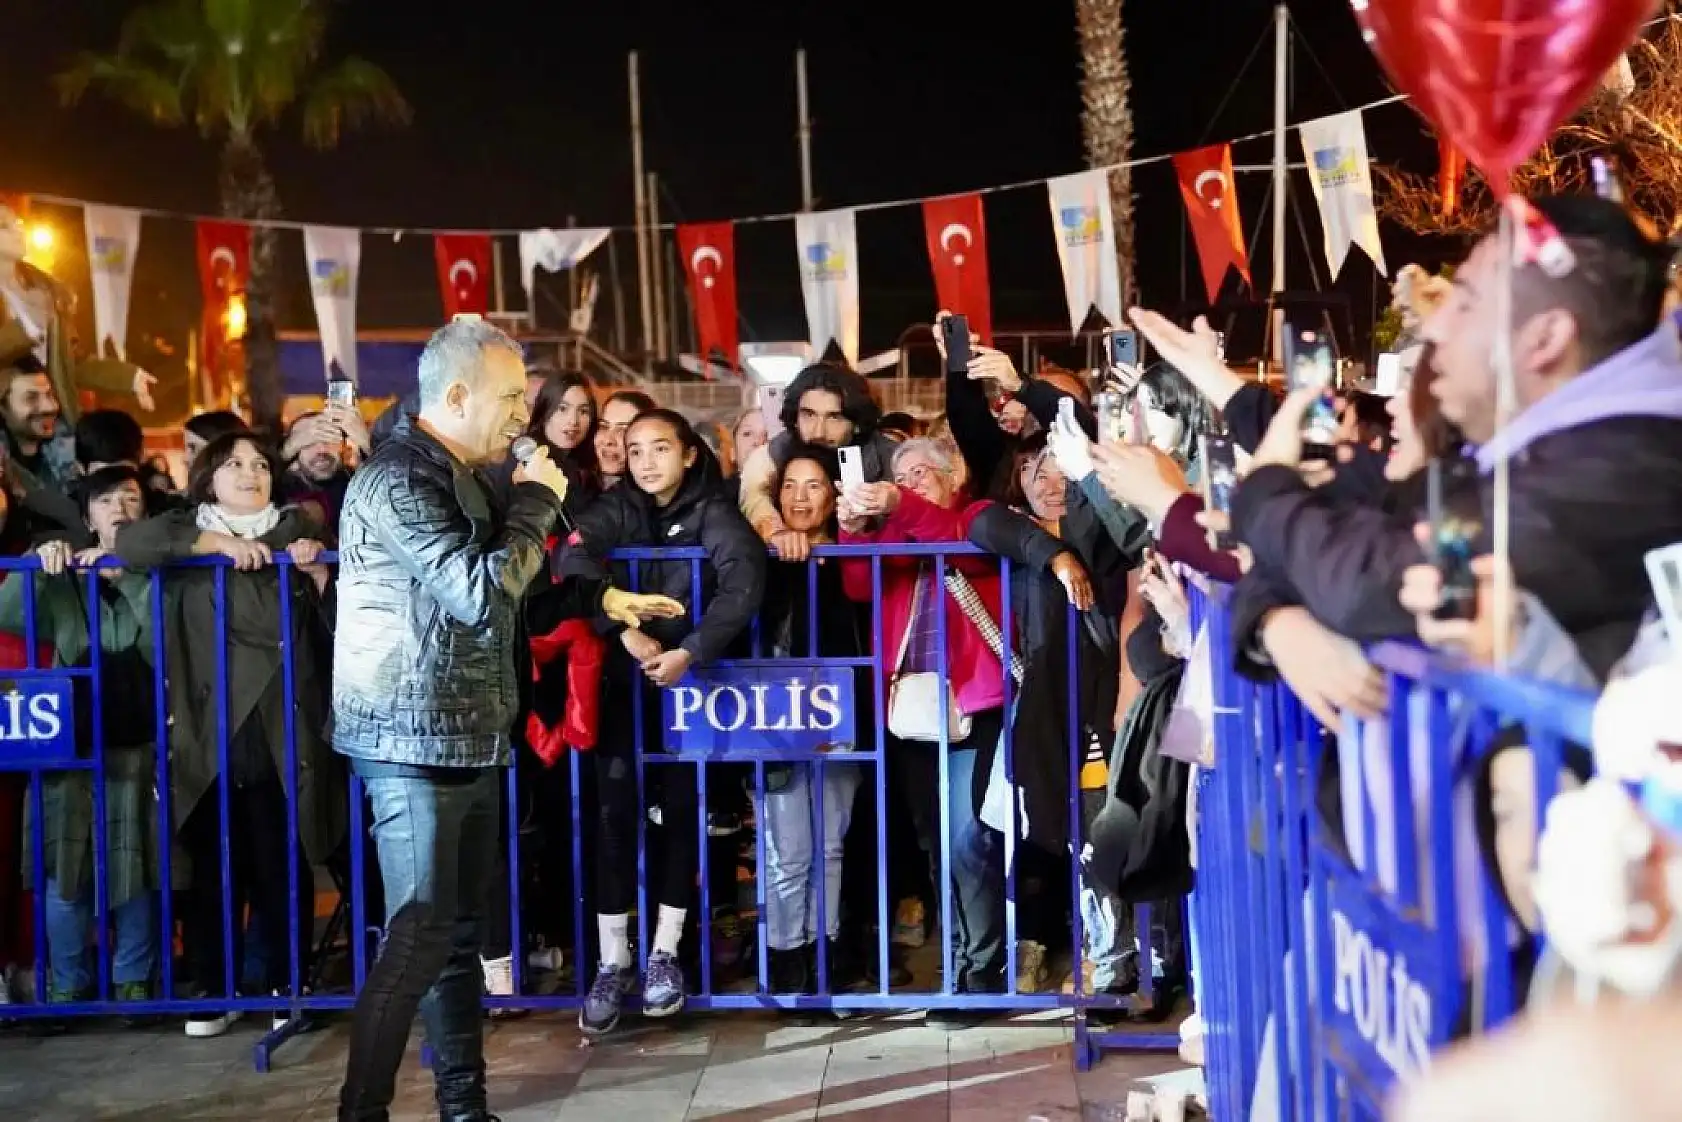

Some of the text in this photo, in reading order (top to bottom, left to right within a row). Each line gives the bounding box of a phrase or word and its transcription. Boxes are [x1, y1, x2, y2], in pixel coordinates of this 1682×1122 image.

[0, 690, 60, 740] İS
[669, 677, 842, 731] POLİS
[1332, 910, 1431, 1079] POLİS
